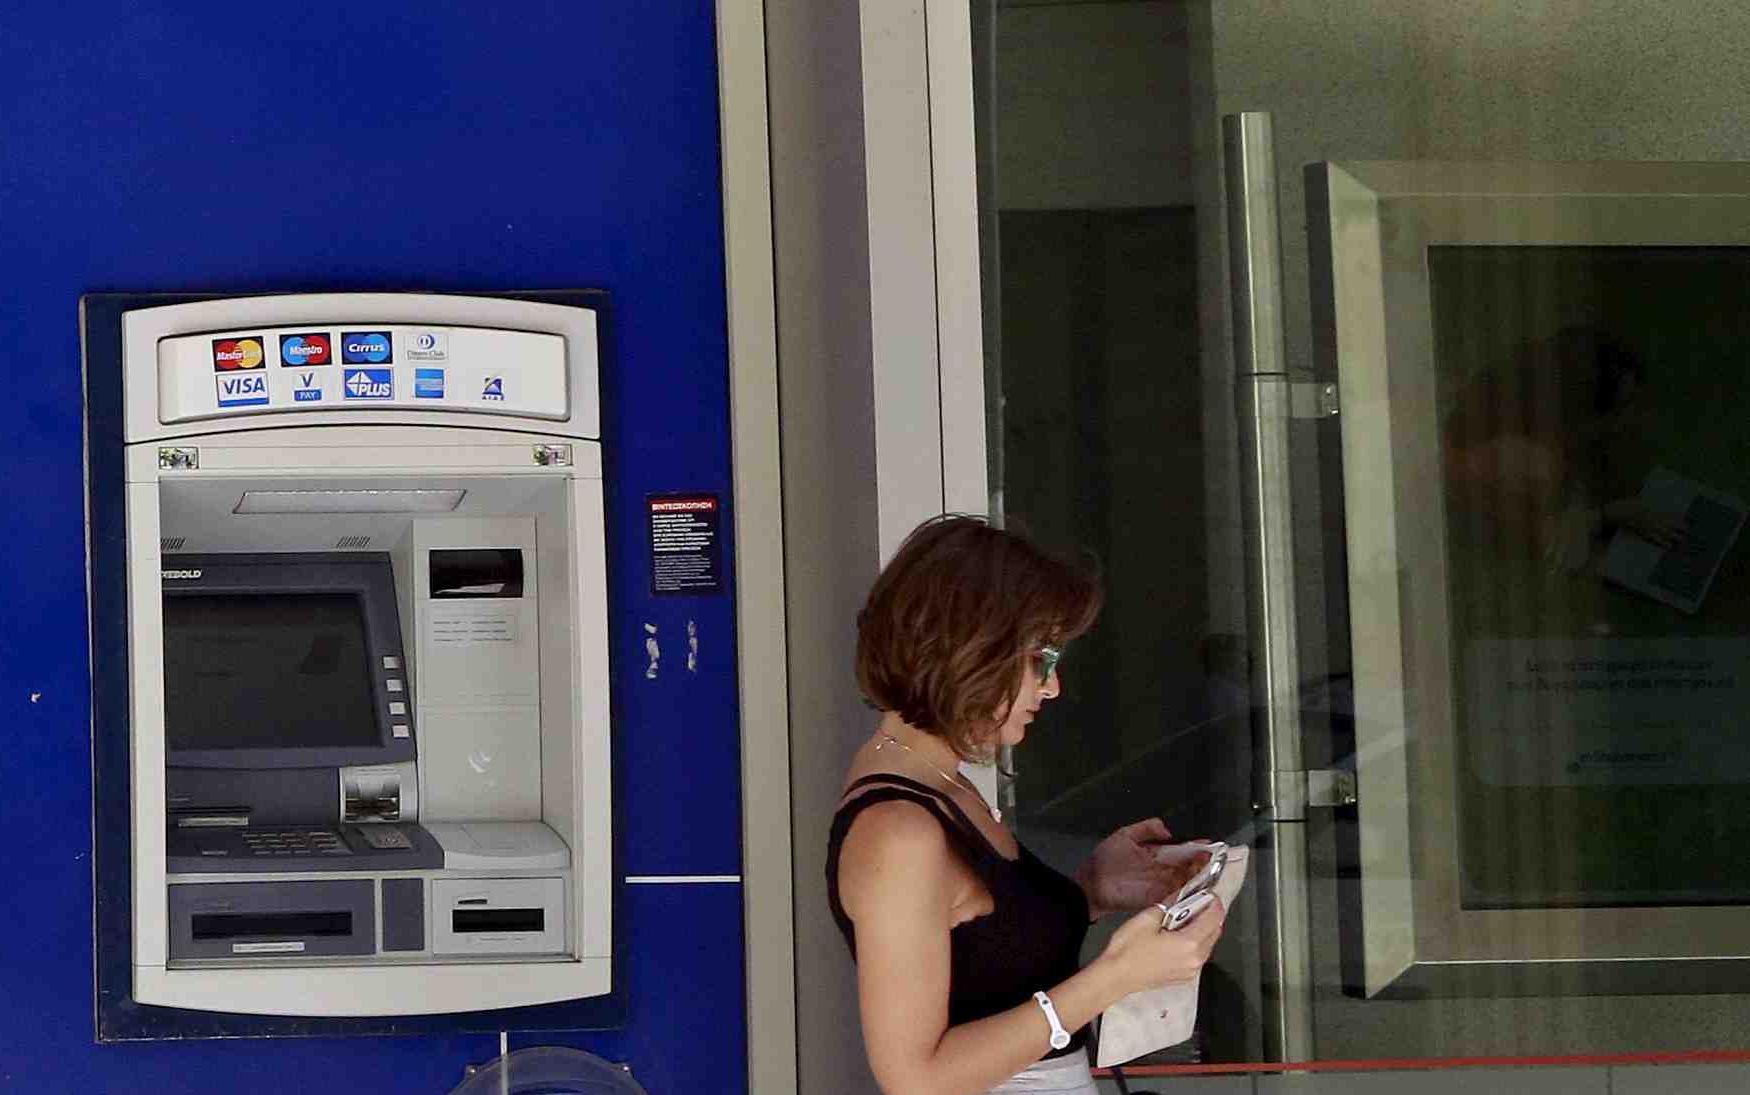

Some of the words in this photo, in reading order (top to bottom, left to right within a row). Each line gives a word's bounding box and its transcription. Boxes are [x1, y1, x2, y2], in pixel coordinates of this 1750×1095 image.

[348, 343, 384, 353] Cirrus
[224, 377, 266, 395] VISA
[300, 373, 314, 388] V
[299, 391, 317, 400] PAY
[358, 383, 391, 397] PLUS
